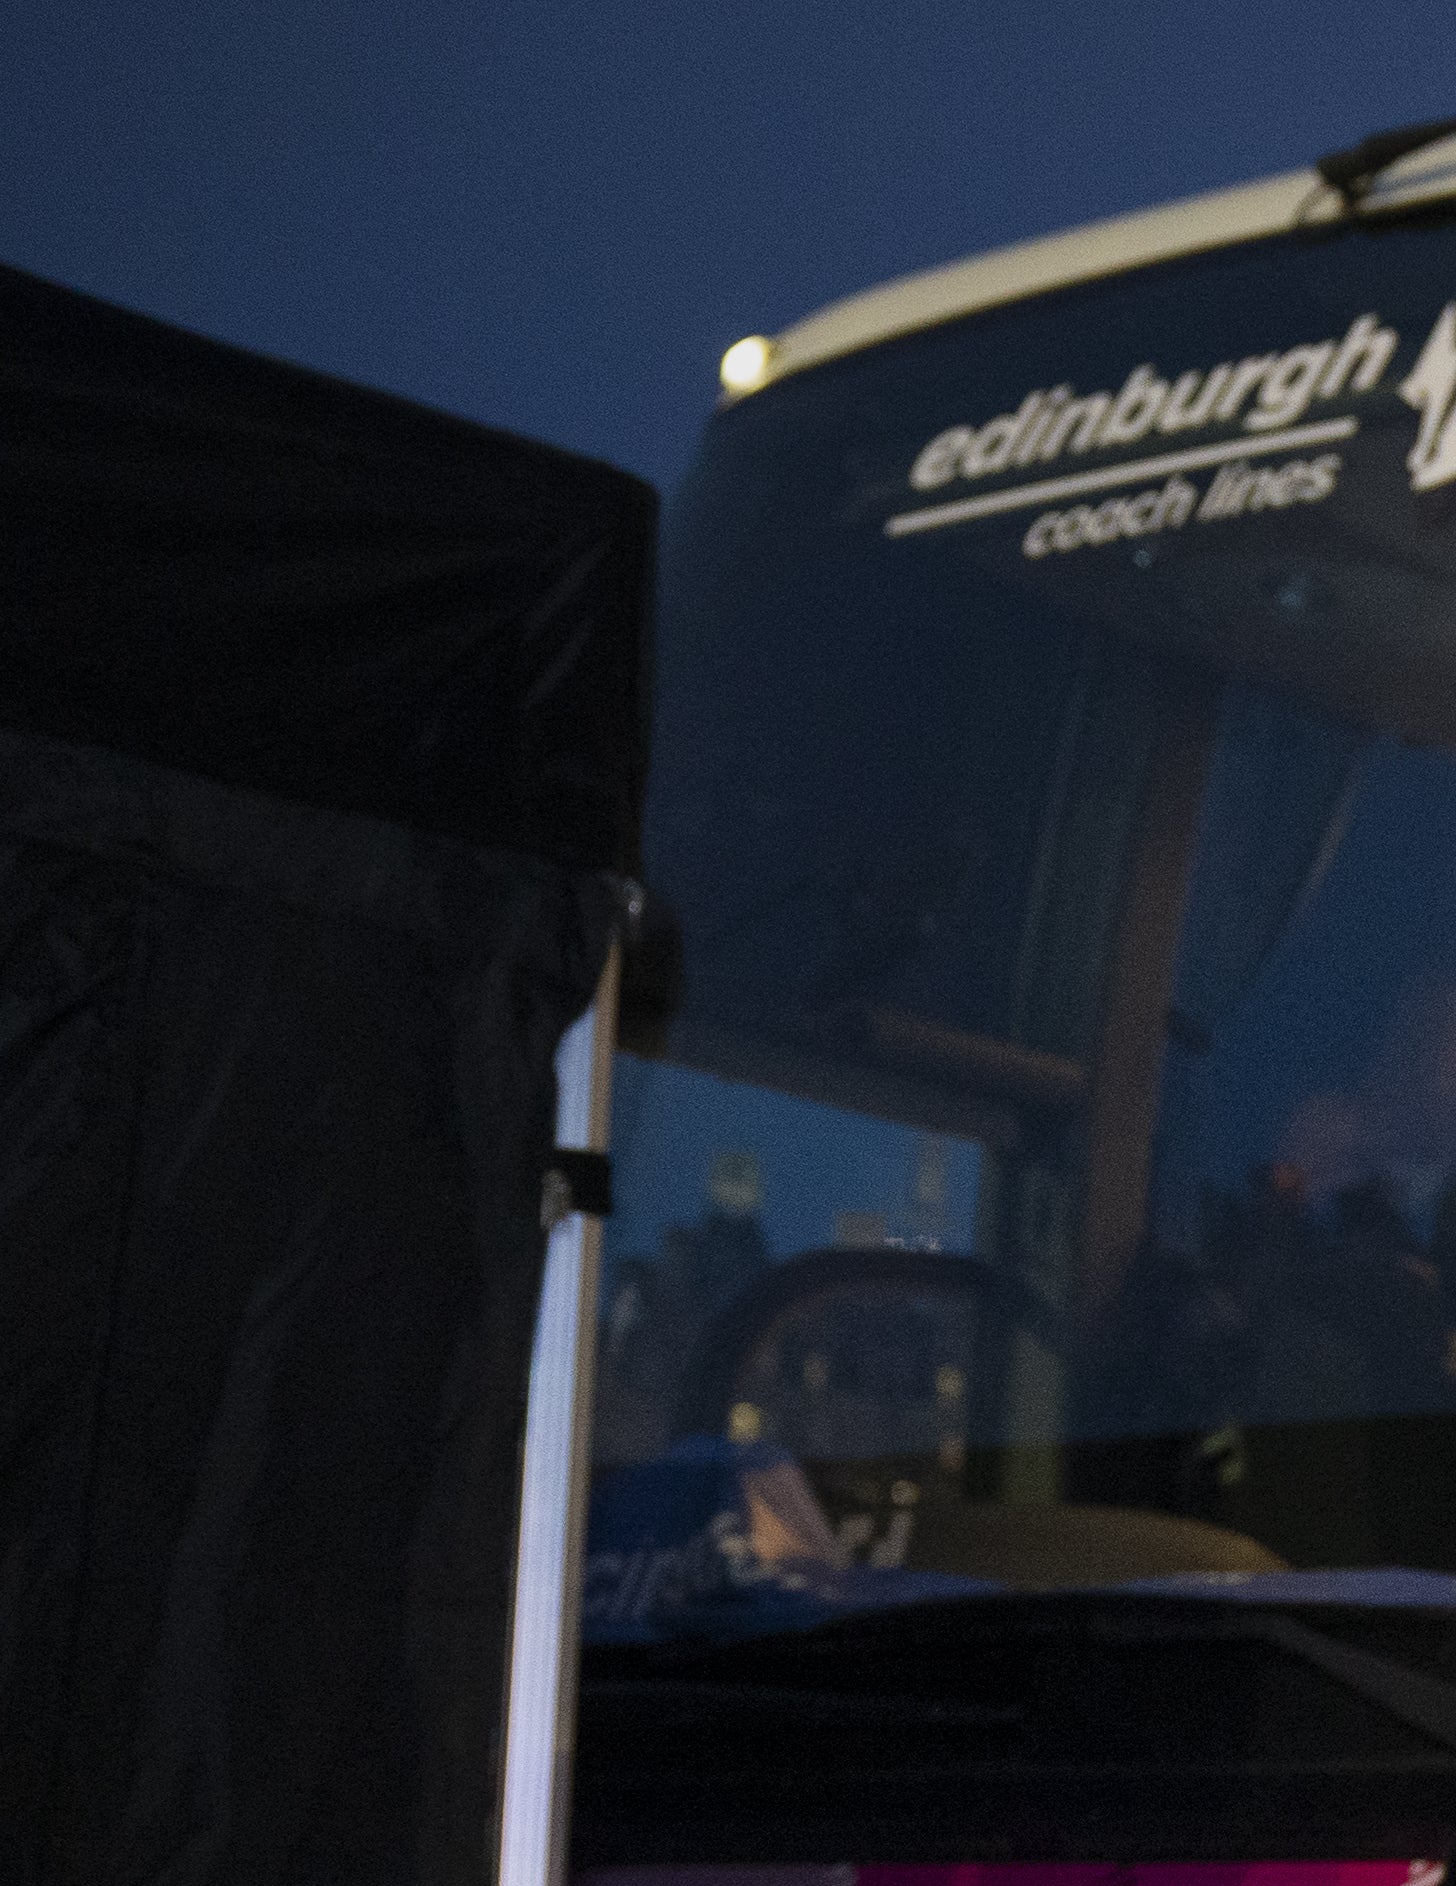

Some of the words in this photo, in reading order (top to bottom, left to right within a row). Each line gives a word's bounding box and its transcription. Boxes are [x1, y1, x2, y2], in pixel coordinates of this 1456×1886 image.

[908, 312, 1400, 492] edinburgh
[1022, 479, 1196, 558] coach
[1198, 452, 1342, 522] lines
